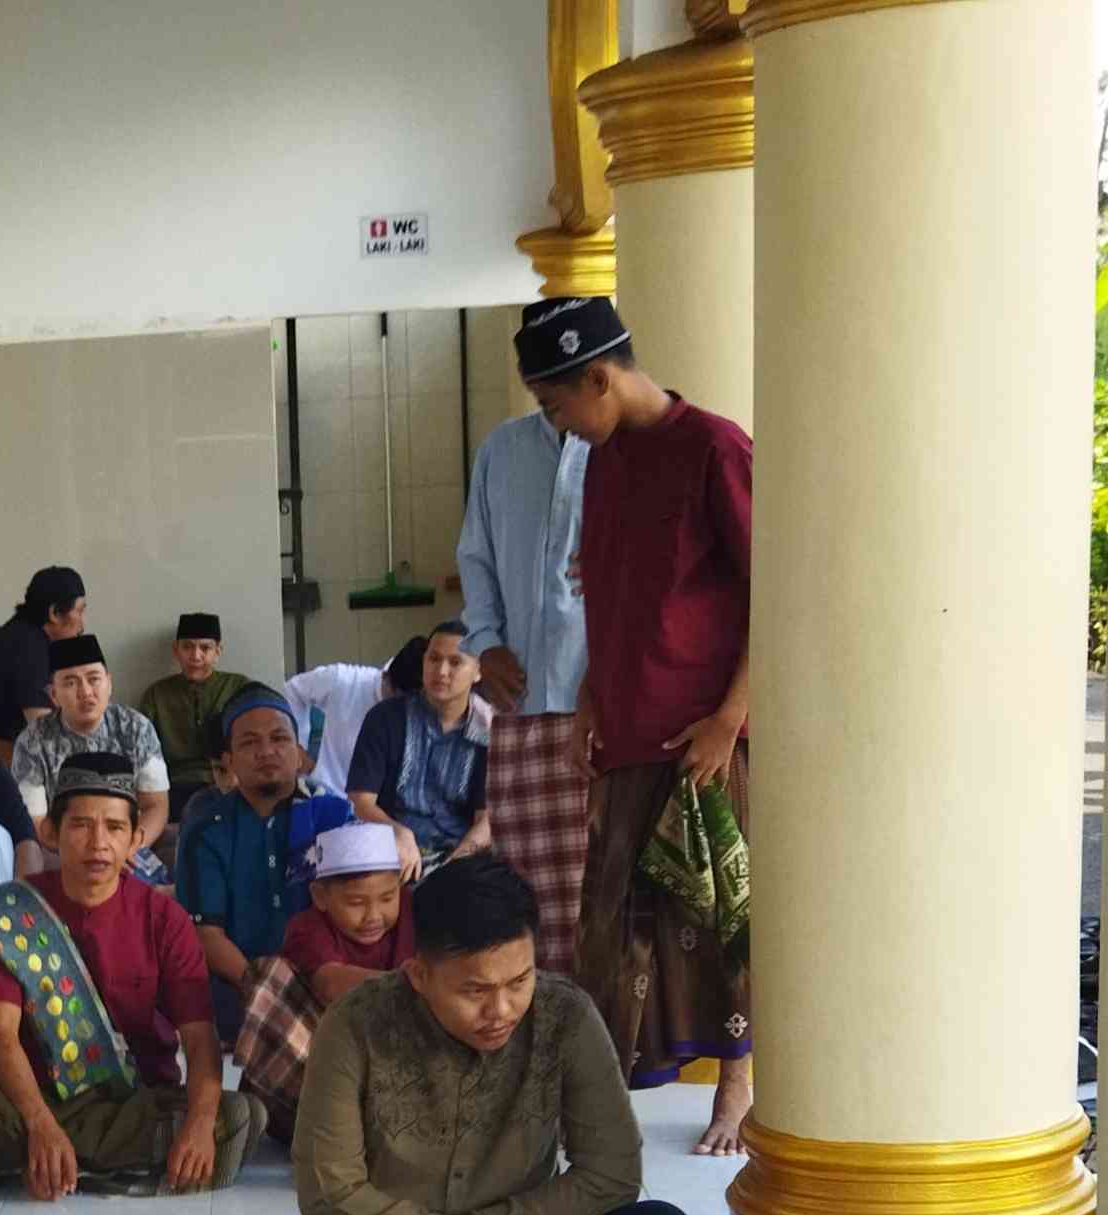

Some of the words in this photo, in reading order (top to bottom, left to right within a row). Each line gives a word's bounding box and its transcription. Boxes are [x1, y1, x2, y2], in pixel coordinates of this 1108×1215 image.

[393, 219, 419, 235] WC
[366, 241, 391, 254] LAKI
[400, 238, 425, 253] LAKI
